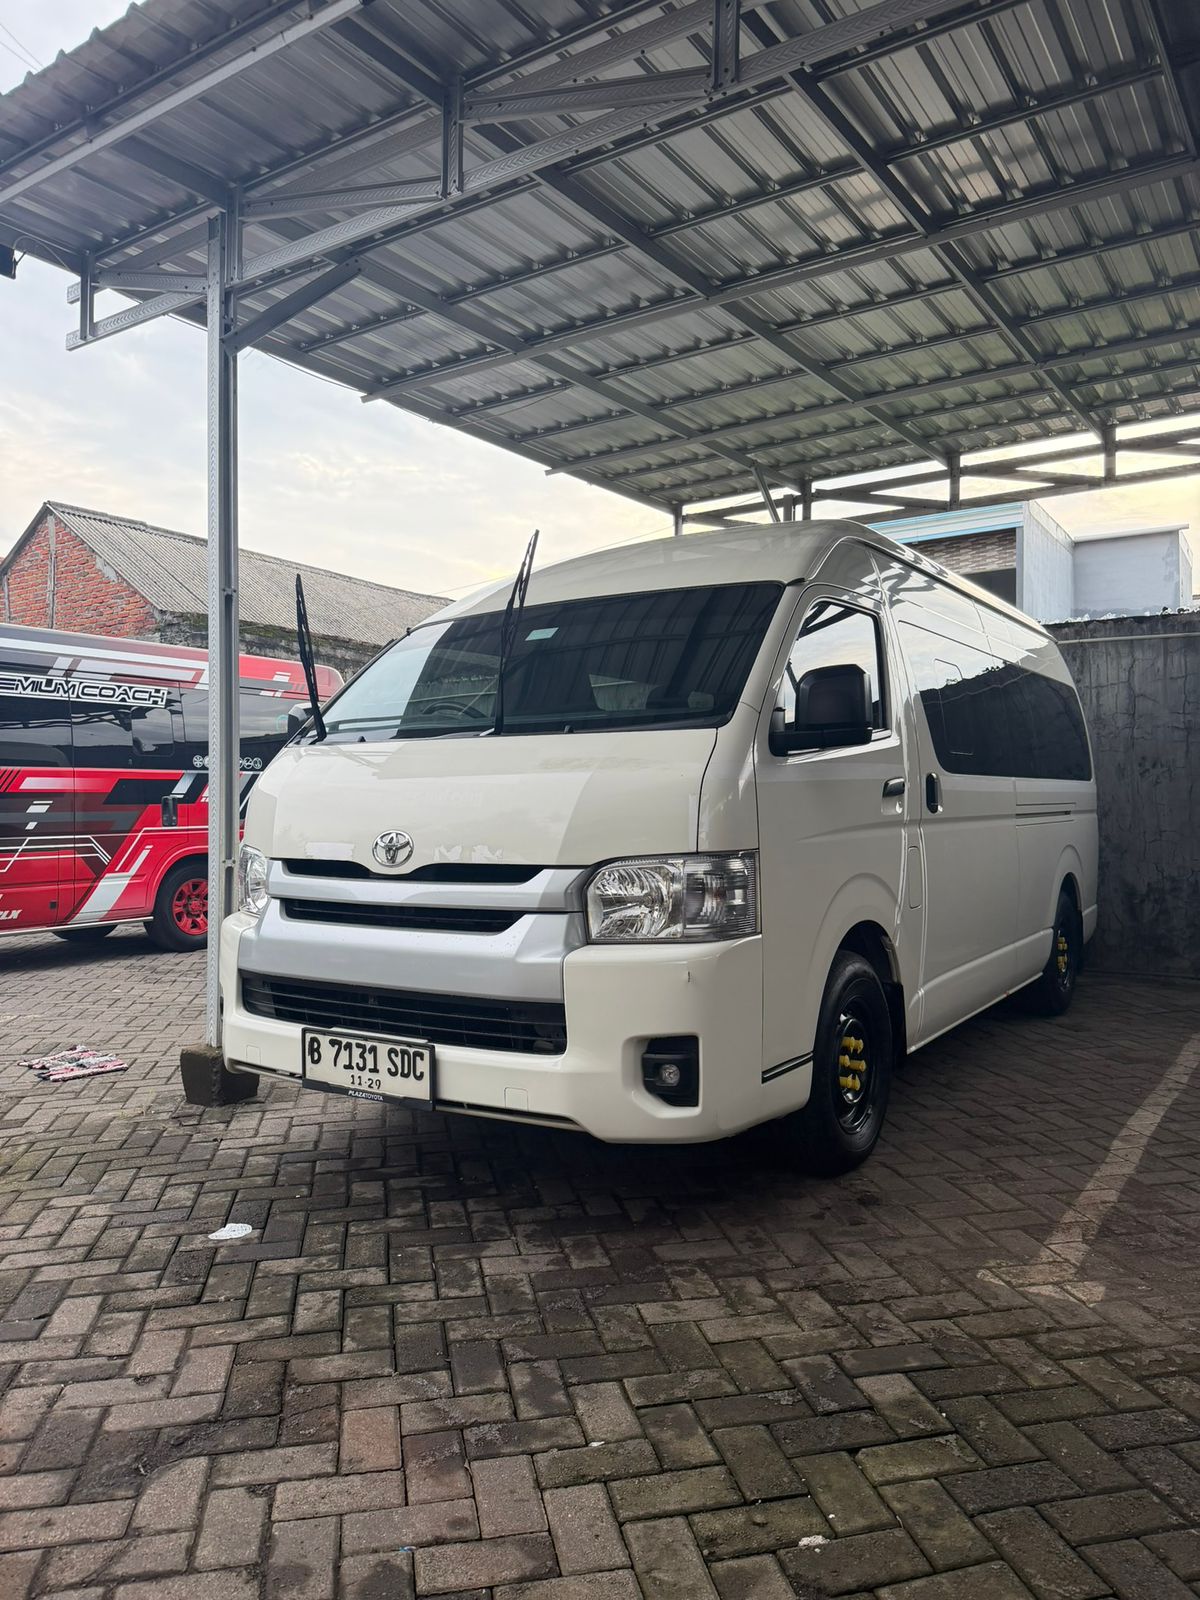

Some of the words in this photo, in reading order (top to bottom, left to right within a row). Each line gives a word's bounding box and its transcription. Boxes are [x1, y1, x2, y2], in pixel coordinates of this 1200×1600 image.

[80, 683, 167, 706] COACH
[308, 1036, 322, 1065] B
[328, 1038, 380, 1074] 7131
[387, 1047, 425, 1081] SDC
